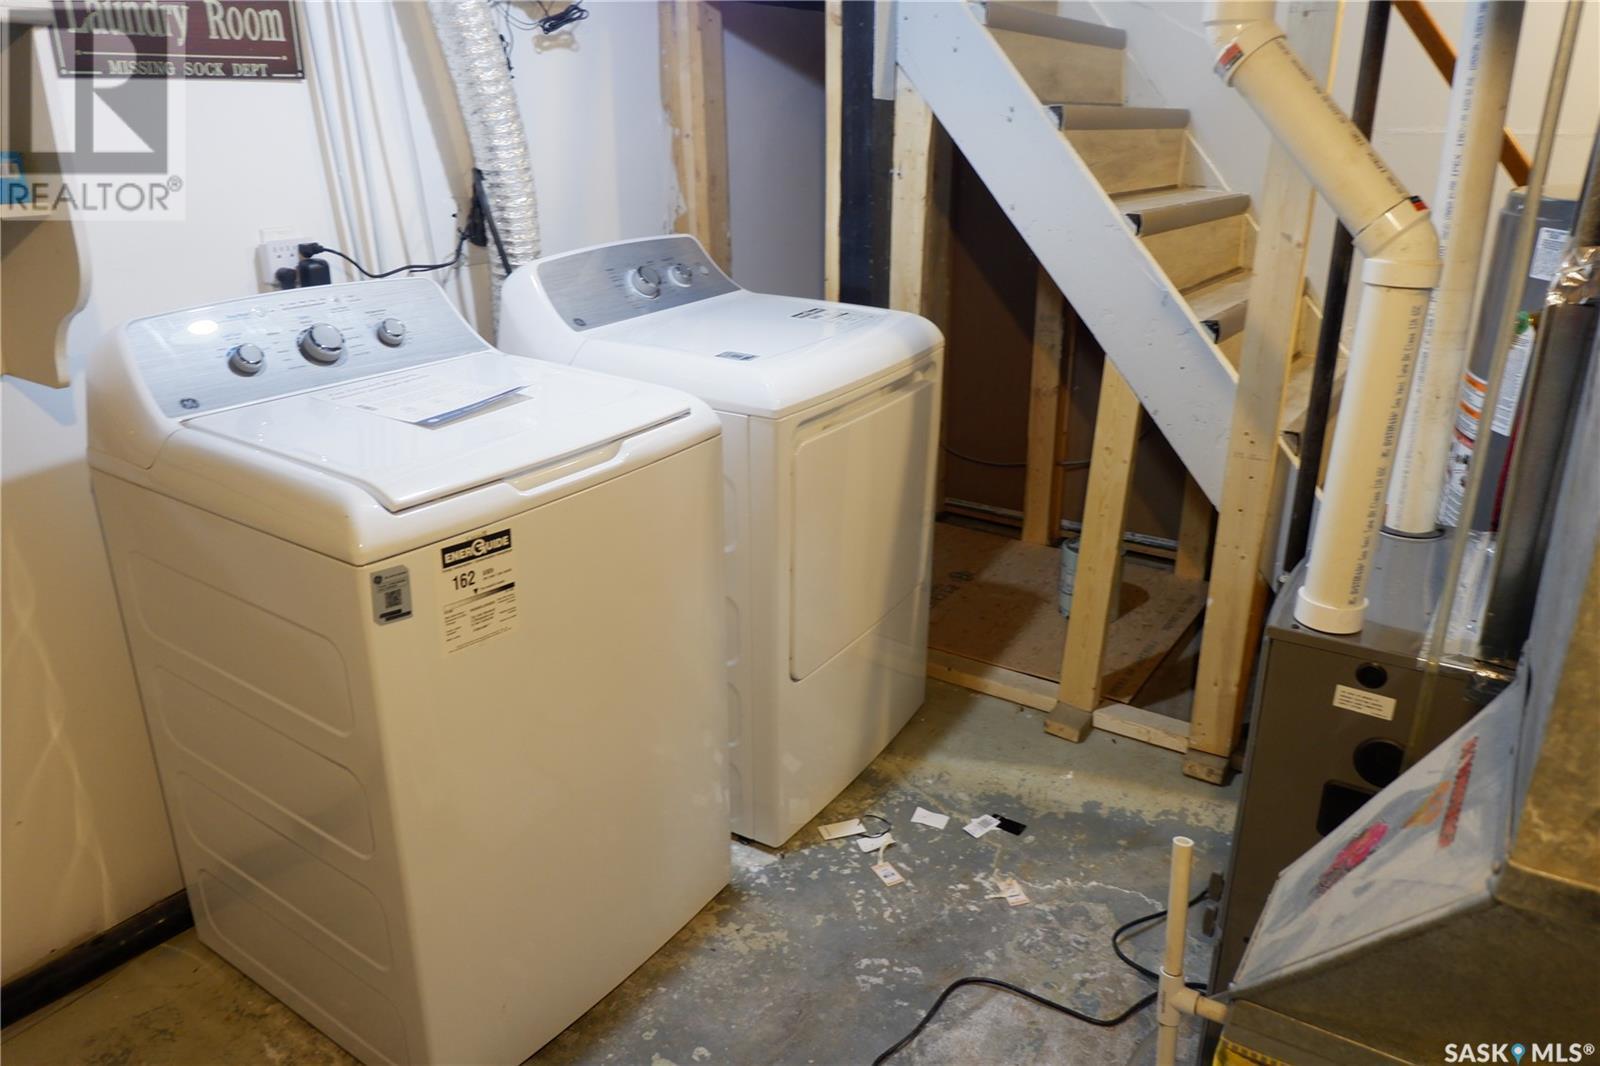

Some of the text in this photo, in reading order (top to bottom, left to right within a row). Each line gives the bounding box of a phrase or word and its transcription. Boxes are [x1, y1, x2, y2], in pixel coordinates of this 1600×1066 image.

[64, 0, 287, 46] Laundry Room
[107, 60, 269, 77] MISSING SOCK DEPT
[444, 536, 510, 563] ENERGUIDE
[452, 570, 476, 590] 162
